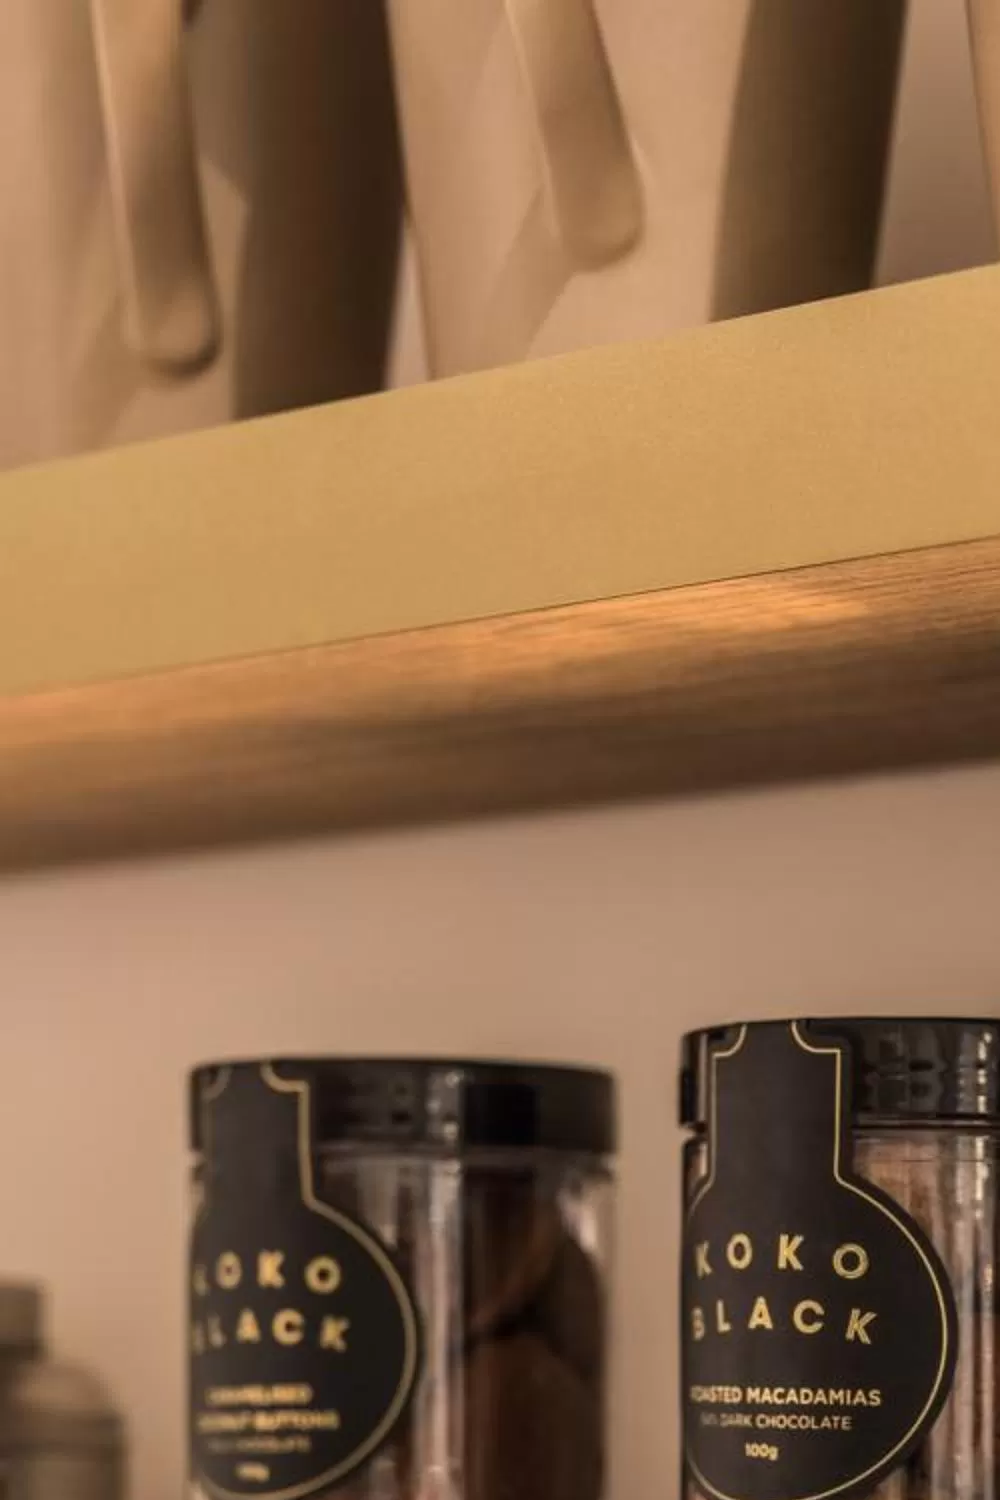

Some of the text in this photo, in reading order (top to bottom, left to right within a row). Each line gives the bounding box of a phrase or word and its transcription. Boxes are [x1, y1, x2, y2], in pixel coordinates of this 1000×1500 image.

[696, 1233, 869, 1280] KOKO
[692, 1296, 877, 1345] BLACK
[690, 1385, 881, 1407] OASTED MACADAMIAS
[755, 1413, 852, 1431] CHOCOLATE
[745, 1442, 778, 1461] 100g
